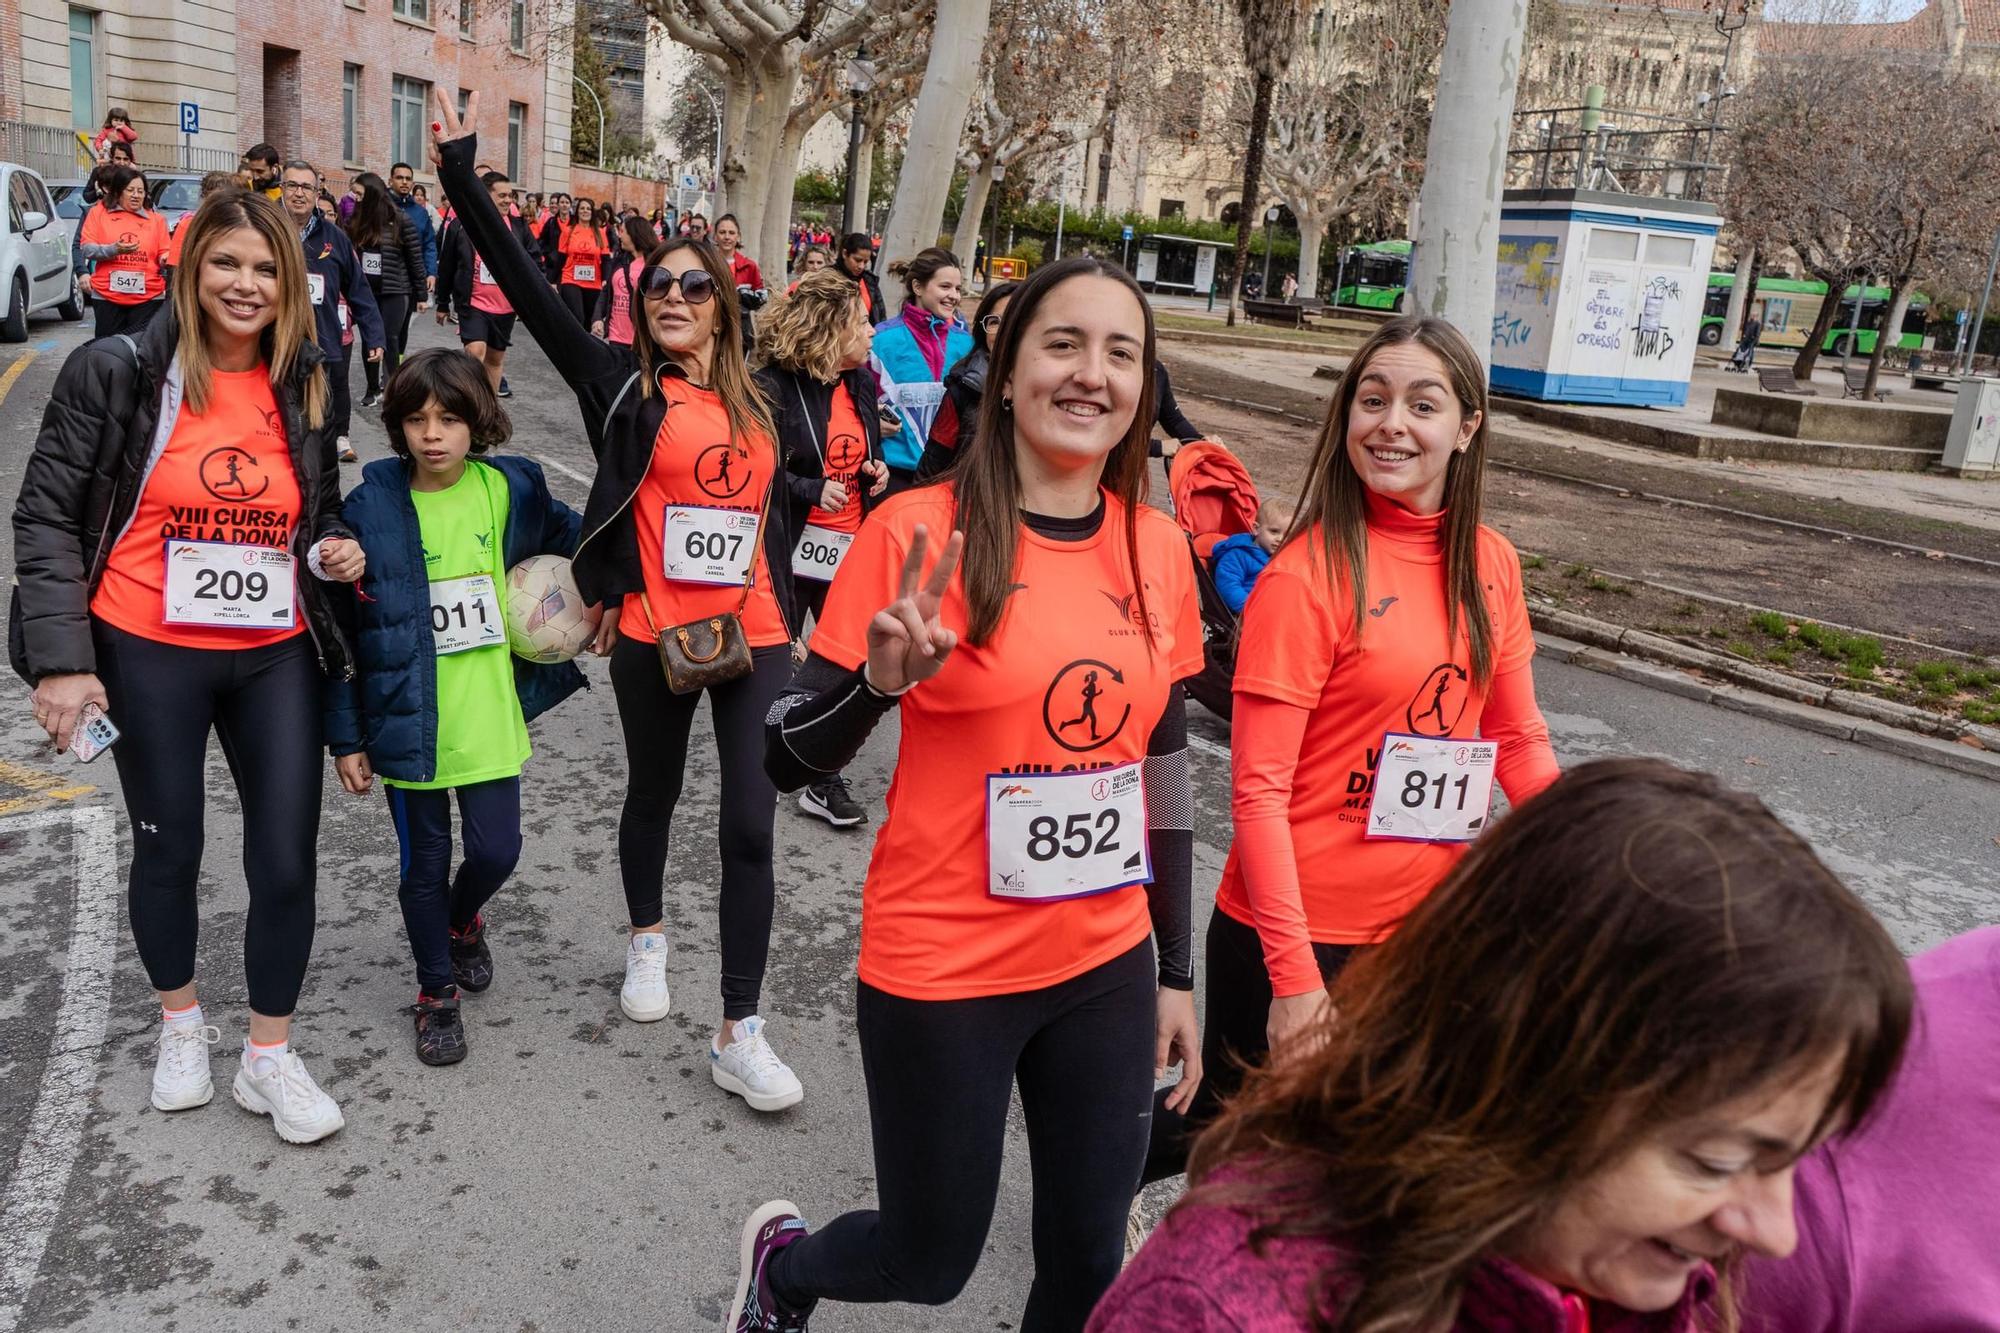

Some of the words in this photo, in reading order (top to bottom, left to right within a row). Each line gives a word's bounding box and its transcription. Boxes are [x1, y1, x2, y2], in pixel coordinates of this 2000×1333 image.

[184, 105, 195, 130] P
[117, 277, 138, 287] 547
[168, 505, 209, 525] VIII
[214, 508, 289, 528] CURSA
[197, 527, 226, 543] LA
[232, 529, 289, 548] DONA
[685, 530, 743, 562] 607
[800, 541, 839, 566] 908
[194, 568, 269, 602] 209
[1112, 781, 1120, 790] DE
[1126, 775, 1139, 786] DONA
[1121, 768, 1137, 780] CURSA
[1400, 769, 1470, 811] 811
[1338, 812, 1368, 825] CIUTA
[1026, 808, 1121, 862] 852
